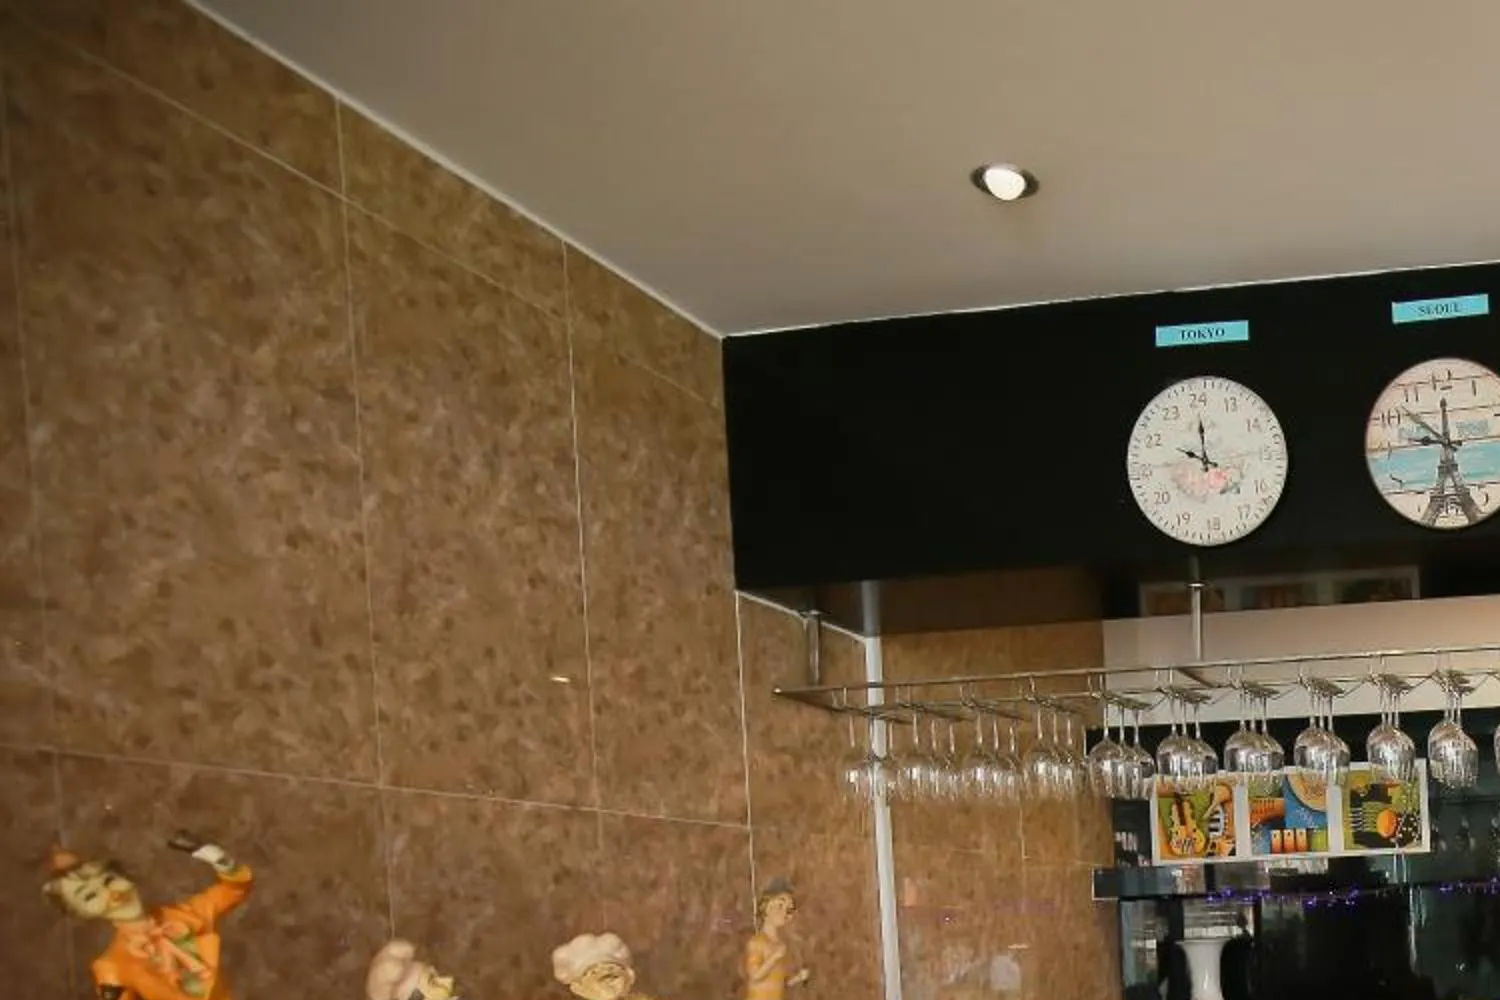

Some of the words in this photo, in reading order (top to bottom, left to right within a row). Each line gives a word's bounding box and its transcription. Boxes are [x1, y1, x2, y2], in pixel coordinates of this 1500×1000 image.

[1418, 302, 1463, 316] SEOUL
[1179, 328, 1225, 340] TOKYO
[1189, 393, 1207, 408] 24
[1224, 397, 1237, 412] 13
[1162, 406, 1180, 420] 23
[1145, 434, 1161, 448] 22
[1153, 492, 1170, 504] 20
[1176, 513, 1190, 526] 19
[1207, 518, 1220, 531] 18
